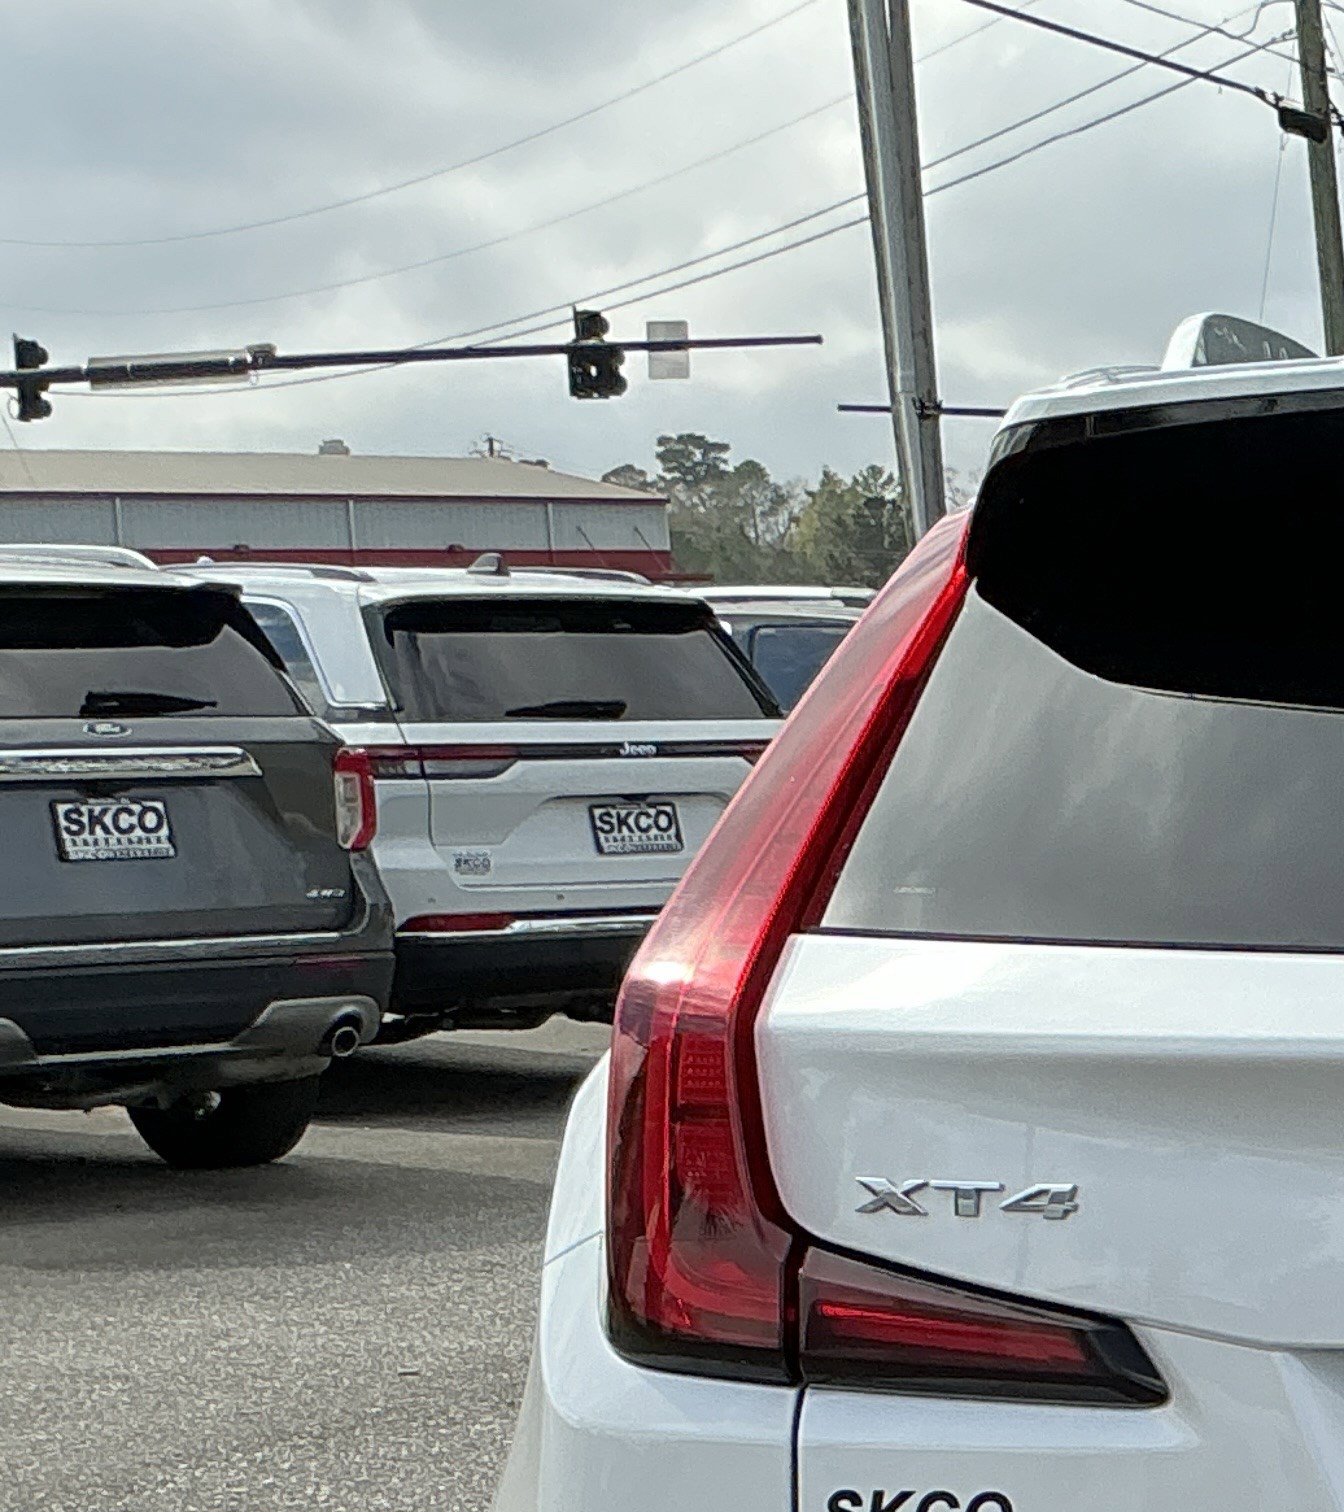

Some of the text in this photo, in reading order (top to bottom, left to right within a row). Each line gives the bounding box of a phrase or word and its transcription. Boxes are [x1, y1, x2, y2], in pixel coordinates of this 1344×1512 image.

[63, 806, 164, 836] SKCO
[597, 810, 673, 834] SKCO
[855, 1176, 1079, 1219] XT4
